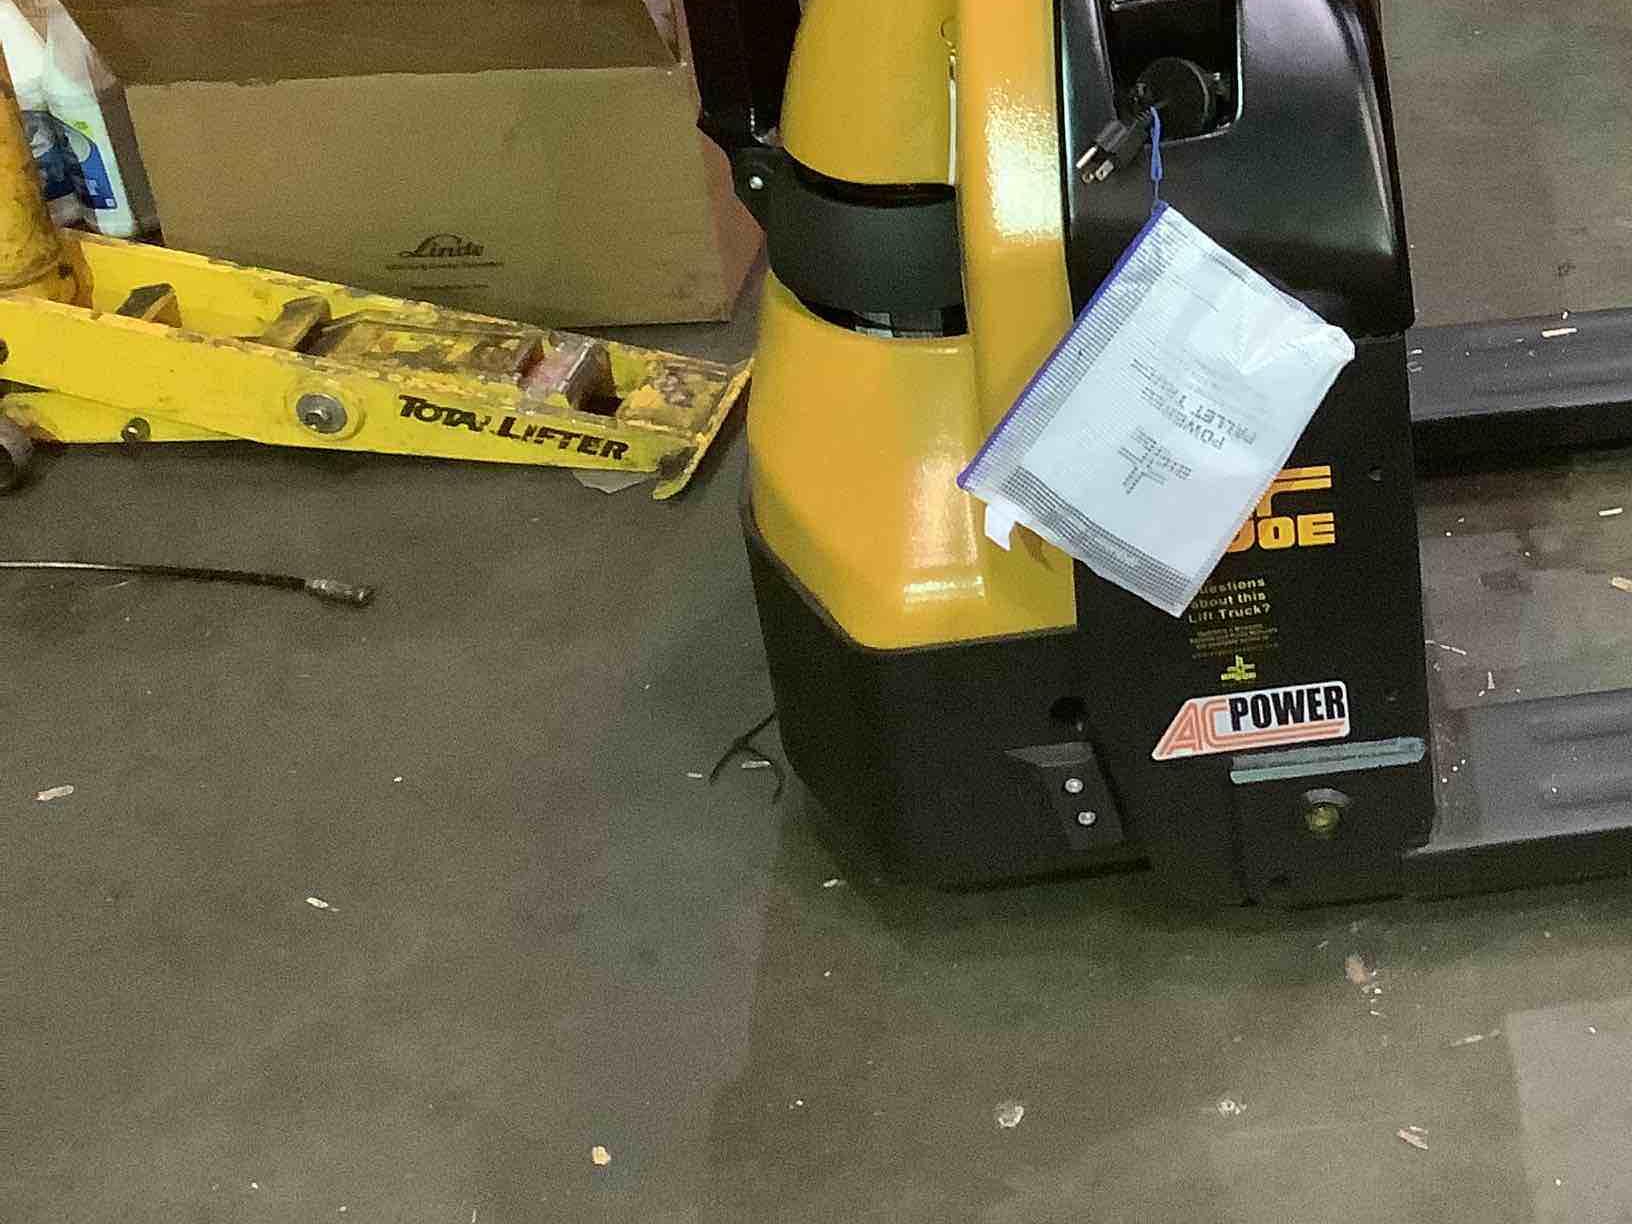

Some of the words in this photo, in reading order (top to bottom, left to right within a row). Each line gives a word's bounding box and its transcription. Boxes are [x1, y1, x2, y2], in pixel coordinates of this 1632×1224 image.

[497, 416, 630, 461] LIFTER
[1200, 578, 1265, 595] uestions
[1218, 603, 1271, 620] Truck?
[1158, 697, 1229, 757] AC
[1228, 685, 1346, 732] POWER
